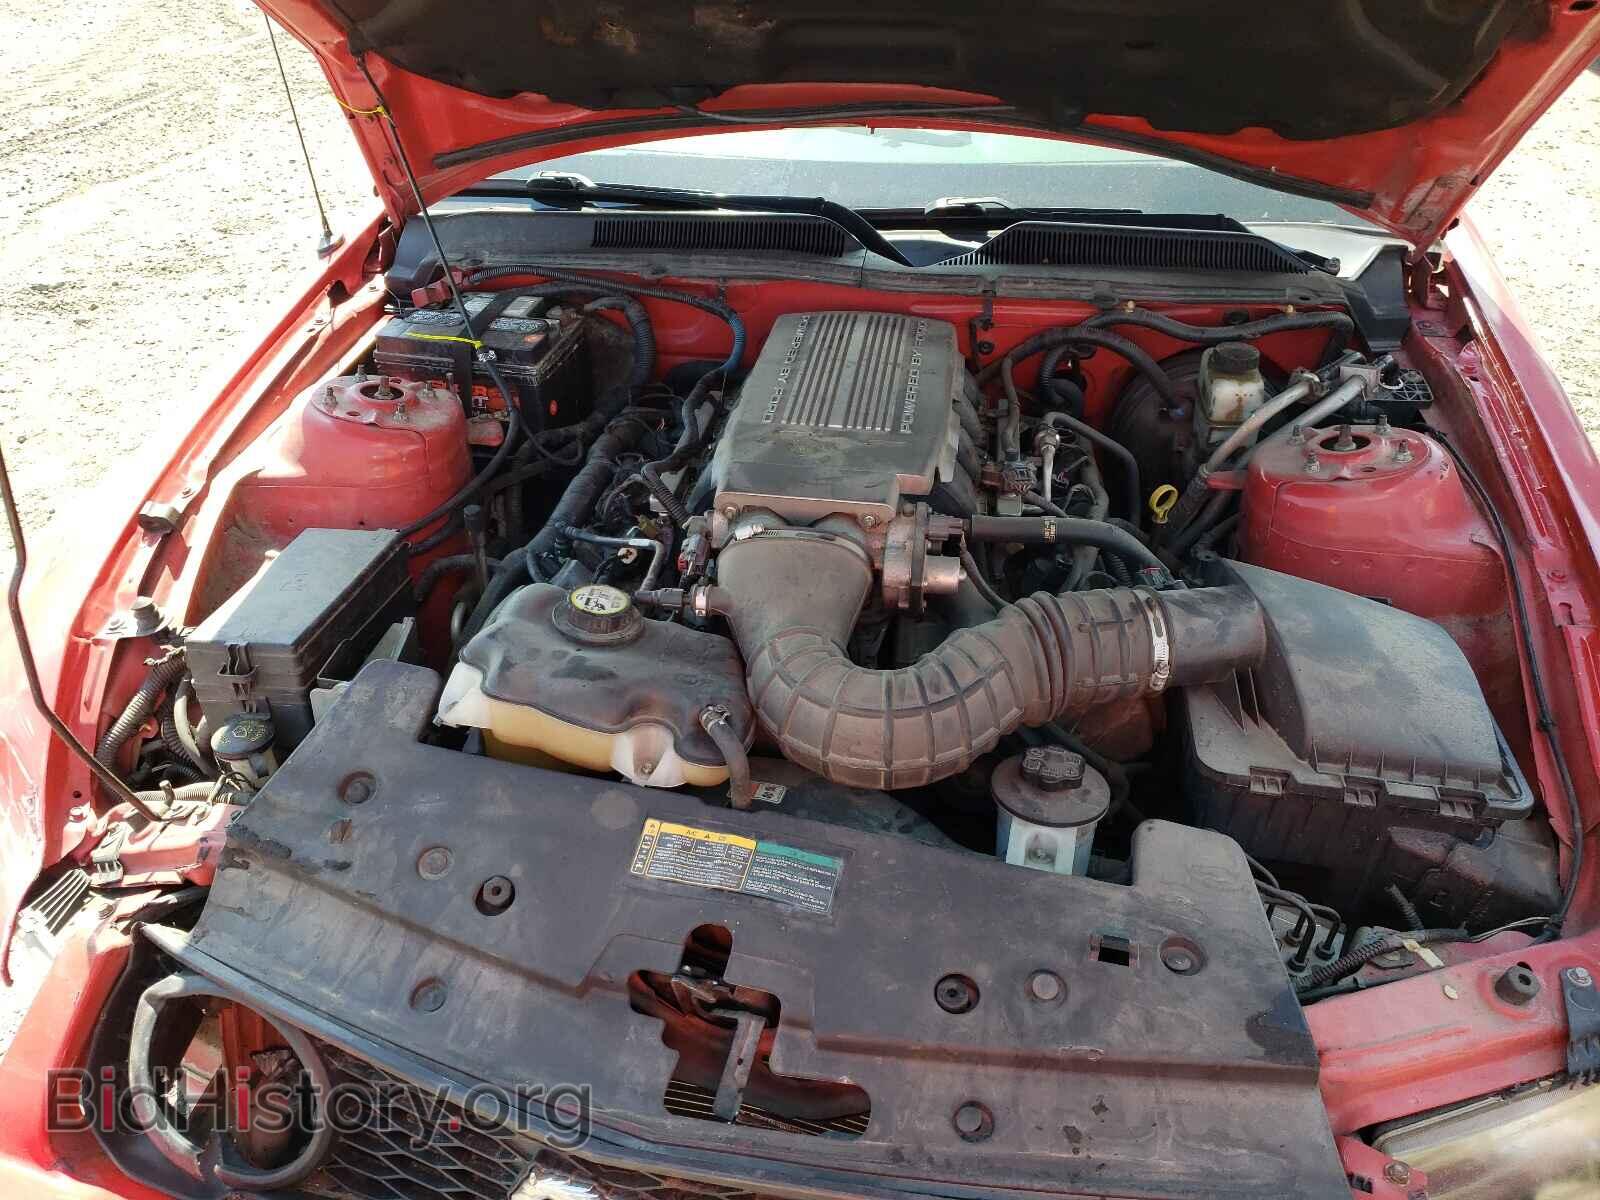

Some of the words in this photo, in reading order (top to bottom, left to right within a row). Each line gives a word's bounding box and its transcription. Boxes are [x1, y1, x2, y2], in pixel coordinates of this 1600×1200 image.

[783, 315, 811, 364] POWERED
[776, 366, 792, 384] BY
[900, 369, 920, 435] POWERED
[911, 348, 921, 366] BY
